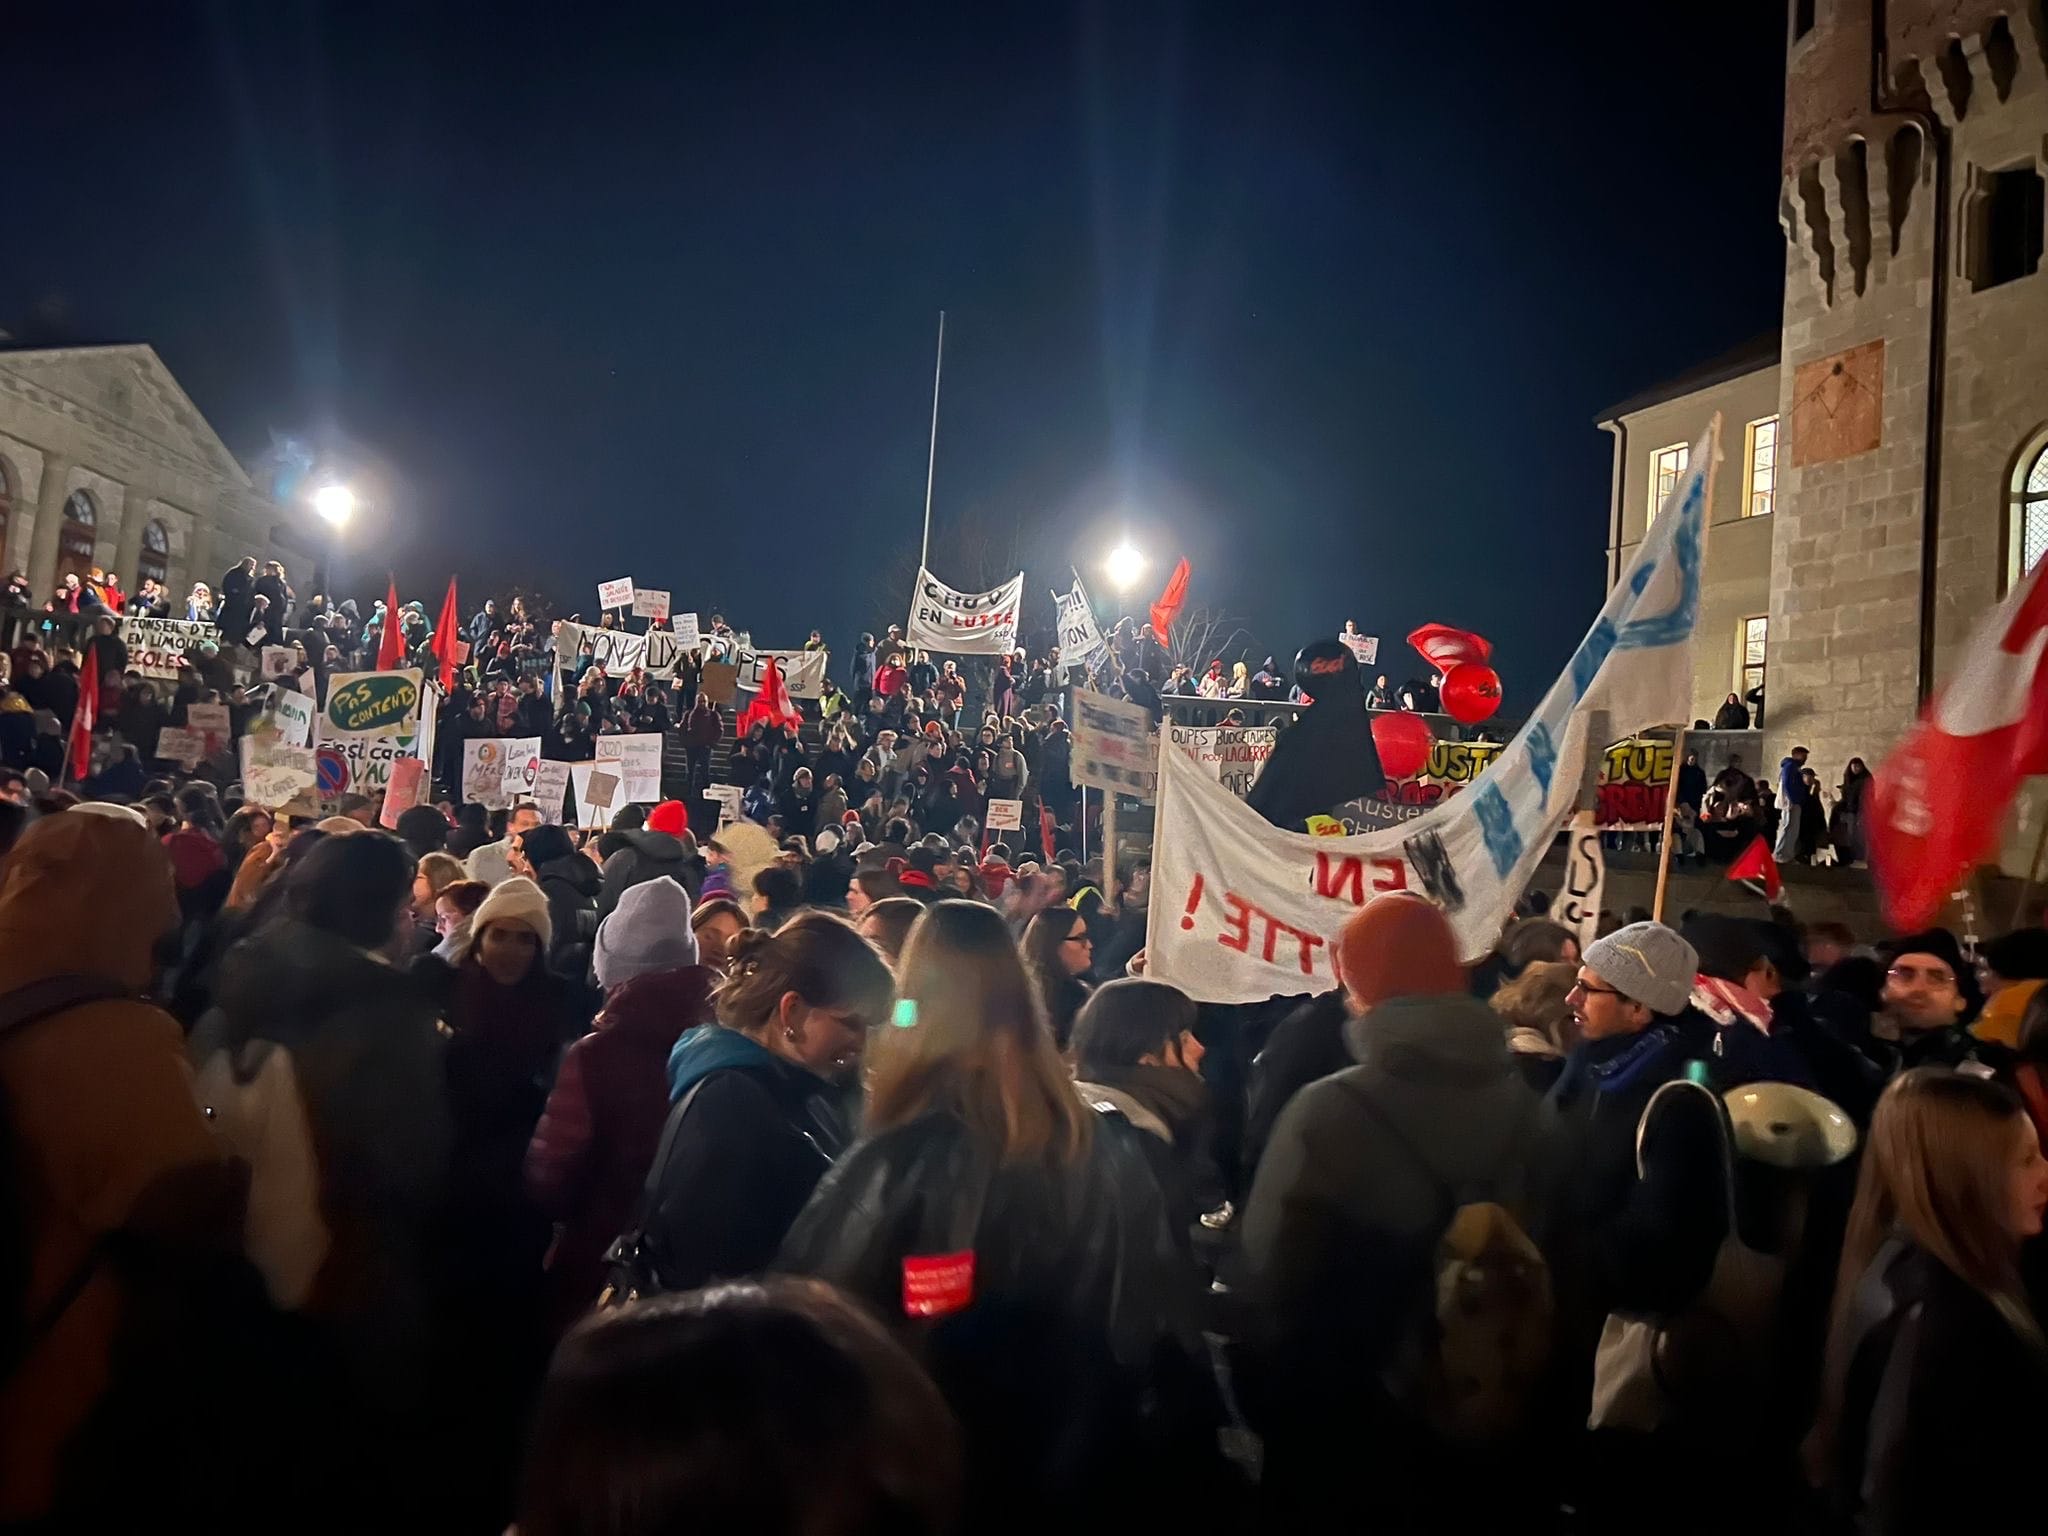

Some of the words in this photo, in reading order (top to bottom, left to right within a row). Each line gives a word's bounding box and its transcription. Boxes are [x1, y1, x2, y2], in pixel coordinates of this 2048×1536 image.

[130, 618, 182, 633] CONSEIL
[919, 608, 942, 624] EN
[953, 608, 1014, 628] LUTTE
[127, 633, 144, 645] EN
[577, 630, 628, 668] NON
[633, 636, 677, 668] AUX
[1171, 728, 1208, 746] OUPES
[1606, 746, 1672, 782] TUE
